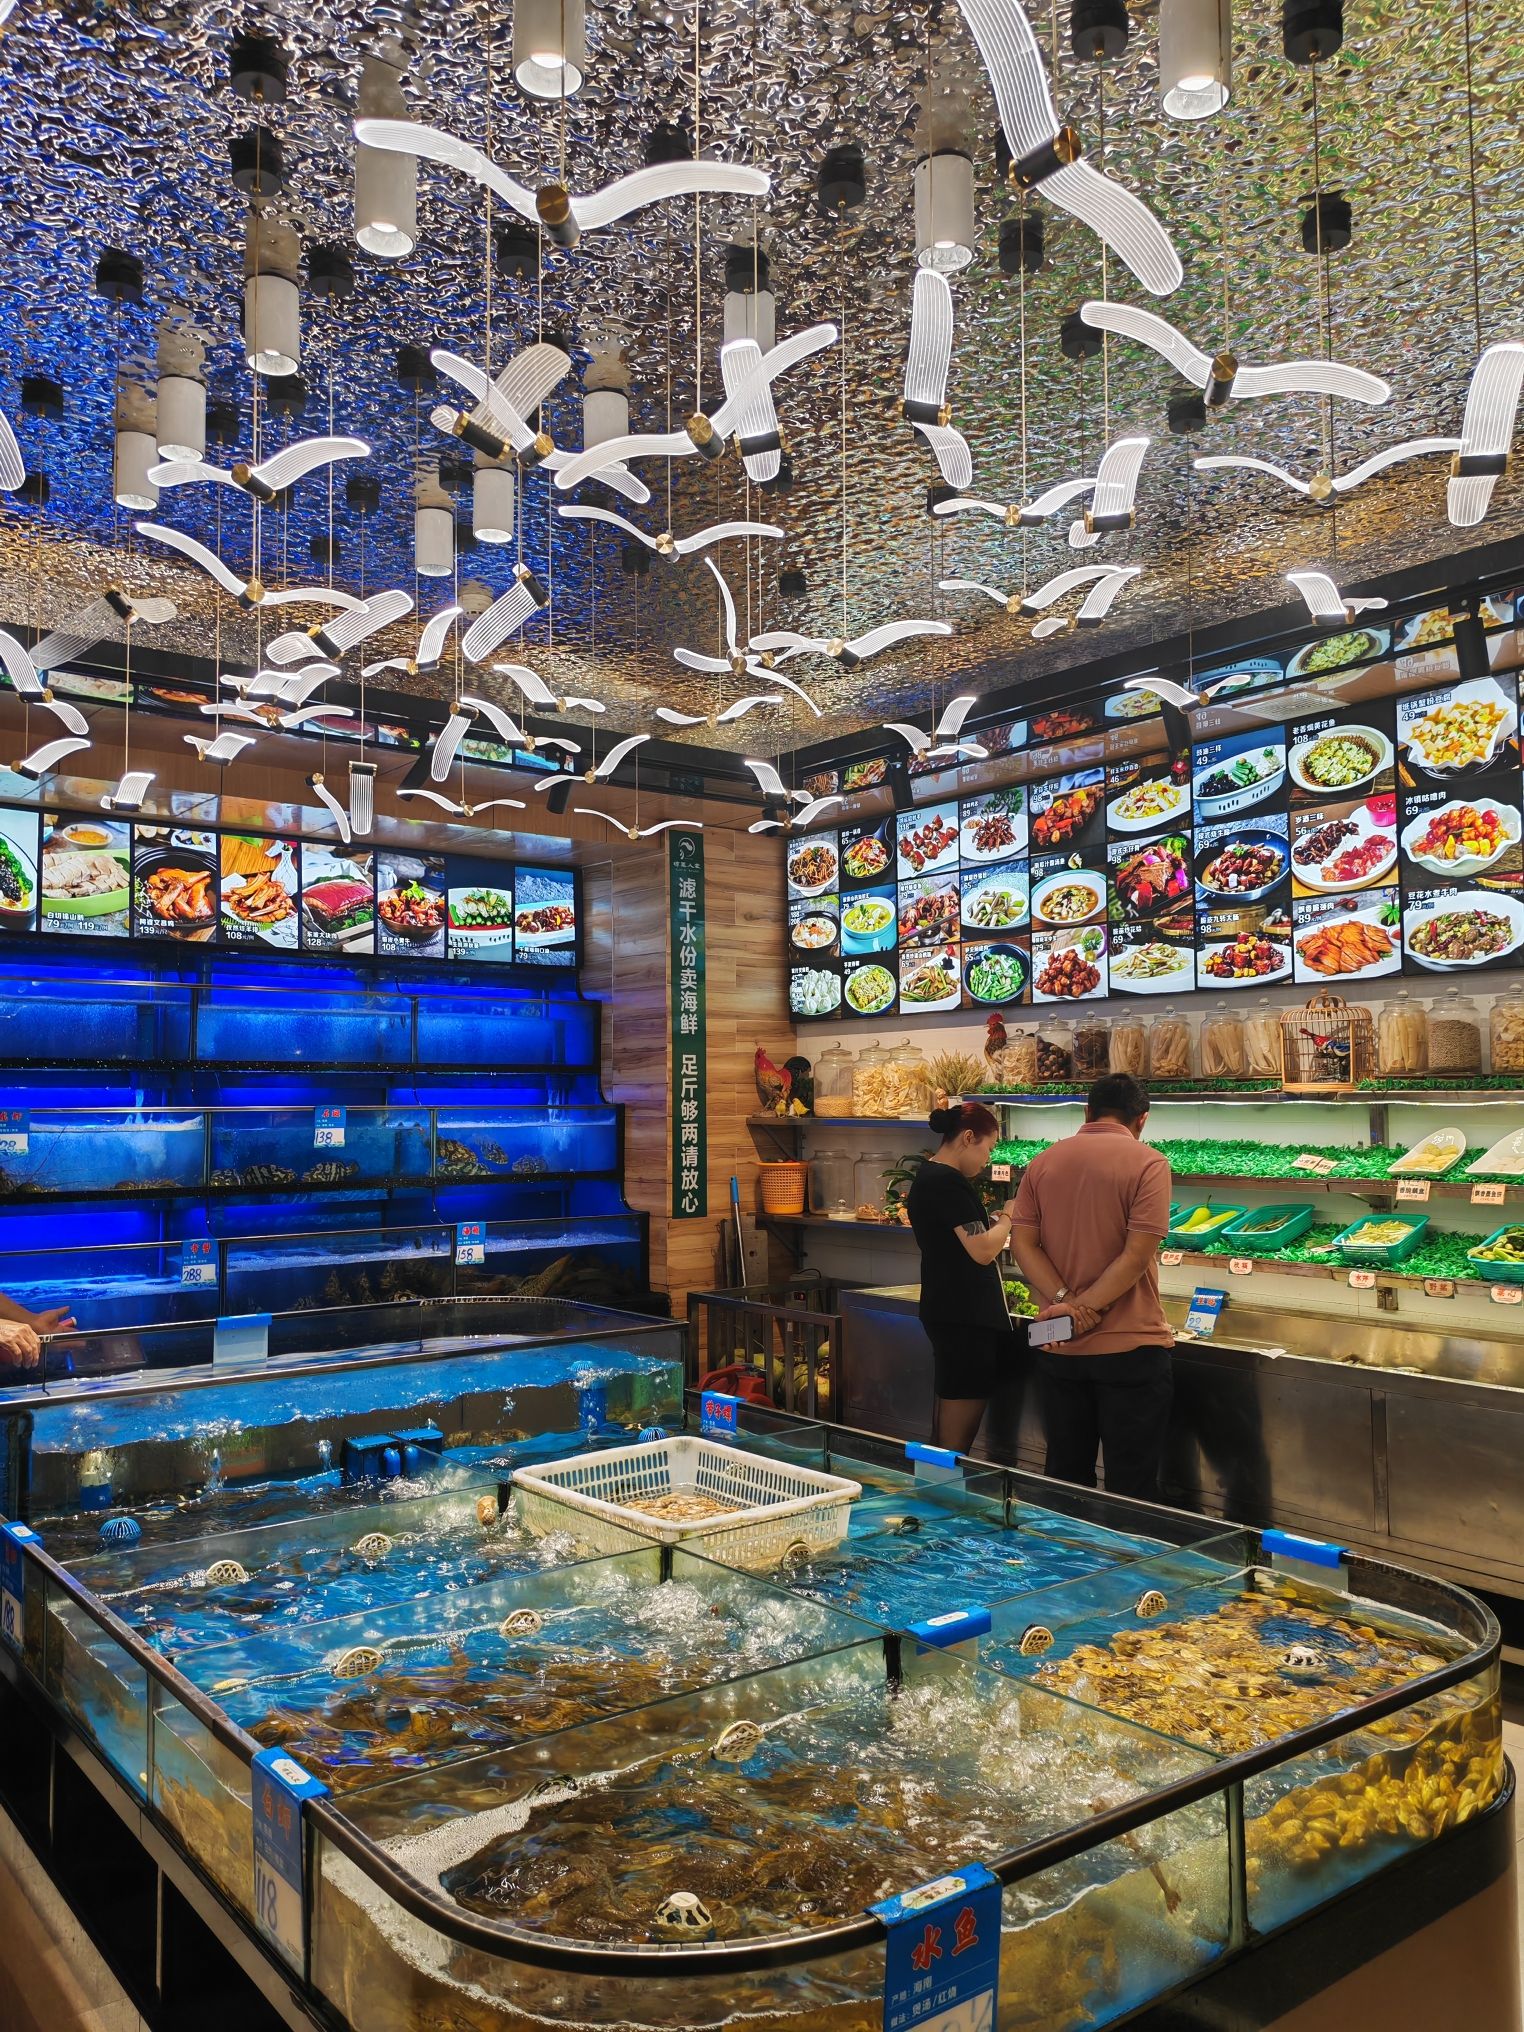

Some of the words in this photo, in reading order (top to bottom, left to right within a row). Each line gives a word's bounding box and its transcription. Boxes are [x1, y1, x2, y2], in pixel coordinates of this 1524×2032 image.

[678, 877, 698, 1036] 滤干水份卖海鲜
[315, 1130, 333, 1144] 138
[680, 1054, 699, 1213] 足斤够两请放心
[457, 1247, 474, 1261] 158
[183, 1267, 202, 1282] 288
[255, 1866, 278, 1931] 118
